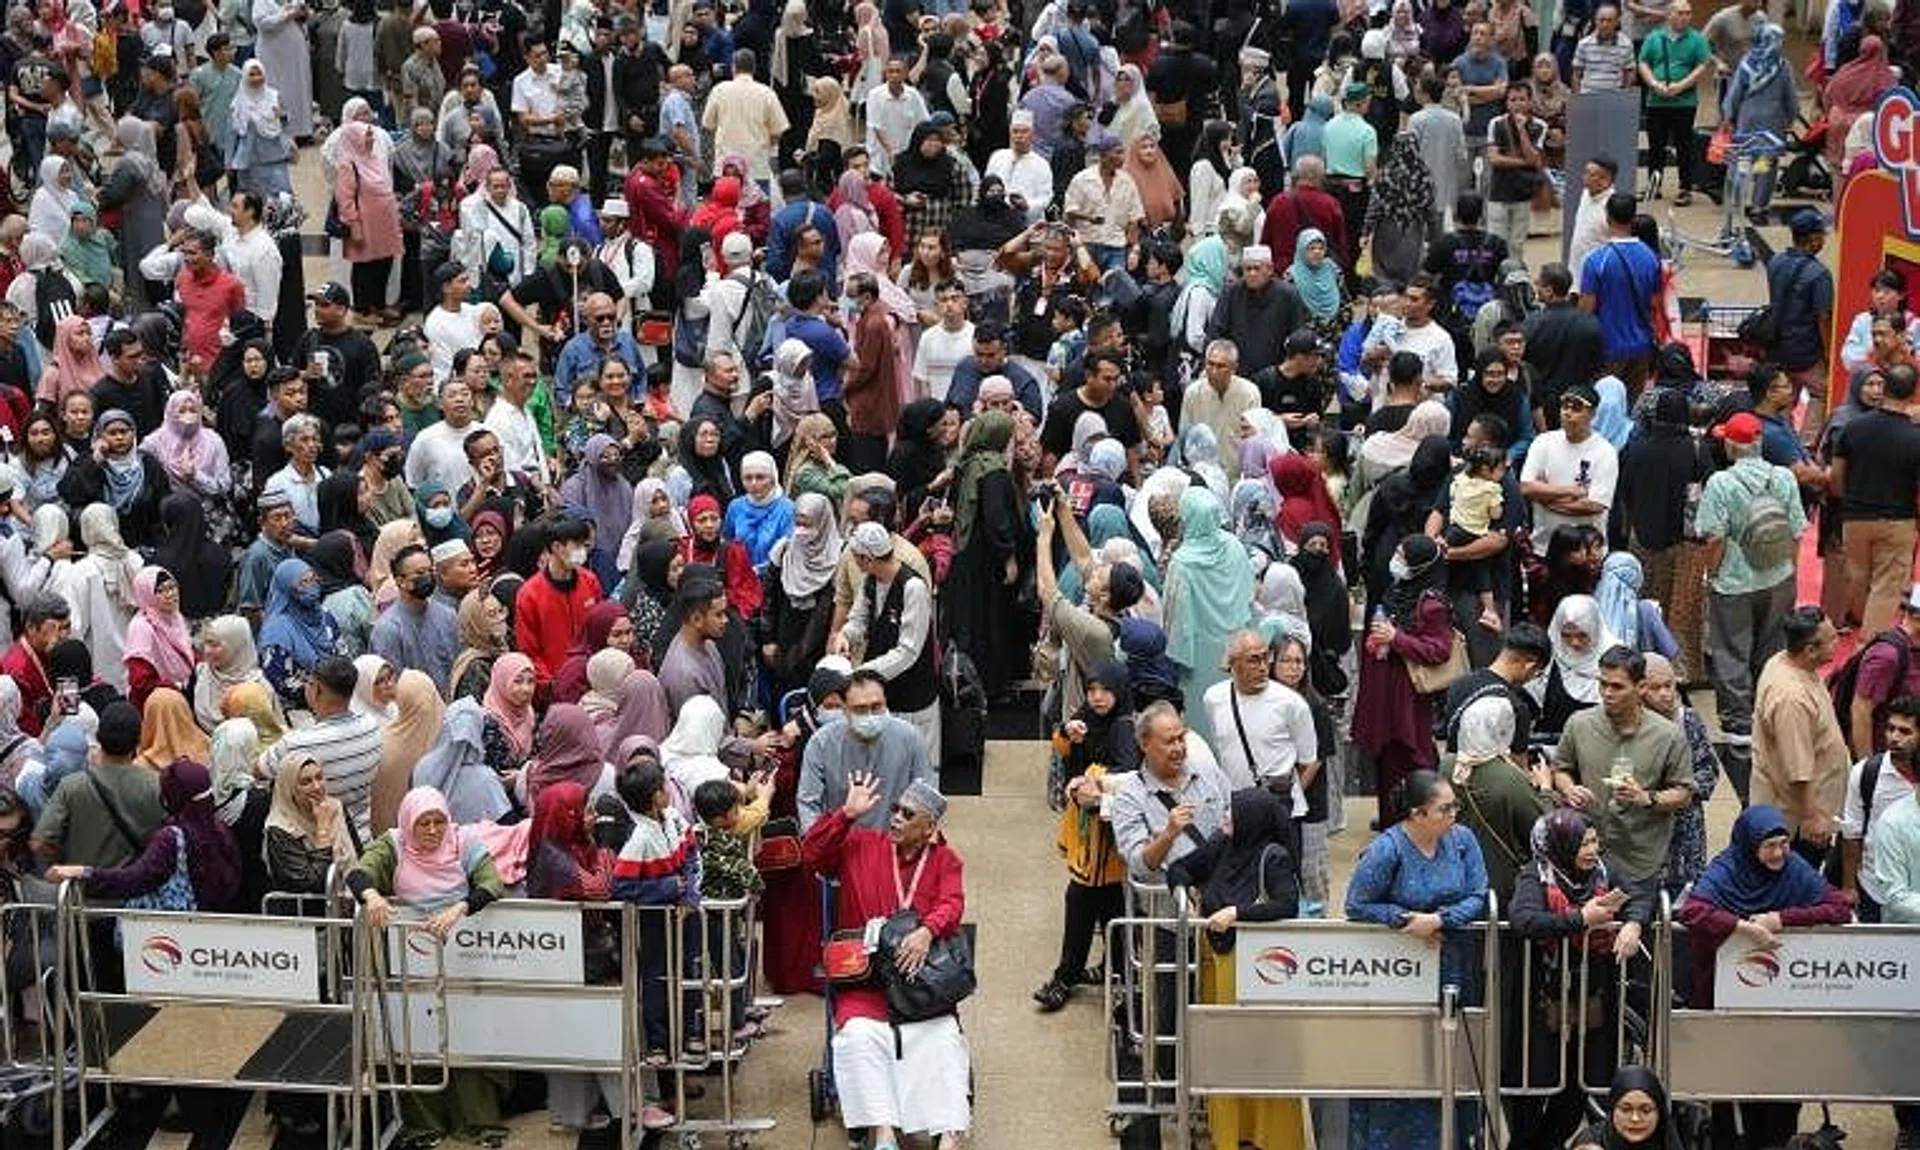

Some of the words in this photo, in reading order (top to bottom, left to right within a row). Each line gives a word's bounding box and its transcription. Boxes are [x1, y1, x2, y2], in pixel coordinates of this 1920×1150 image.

[1879, 97, 1920, 166] G
[455, 929, 565, 950] CHANGI
[190, 948, 299, 971] CHANGI
[1306, 957, 1421, 977] CHANGI
[1788, 959, 1908, 980] CHANGI
